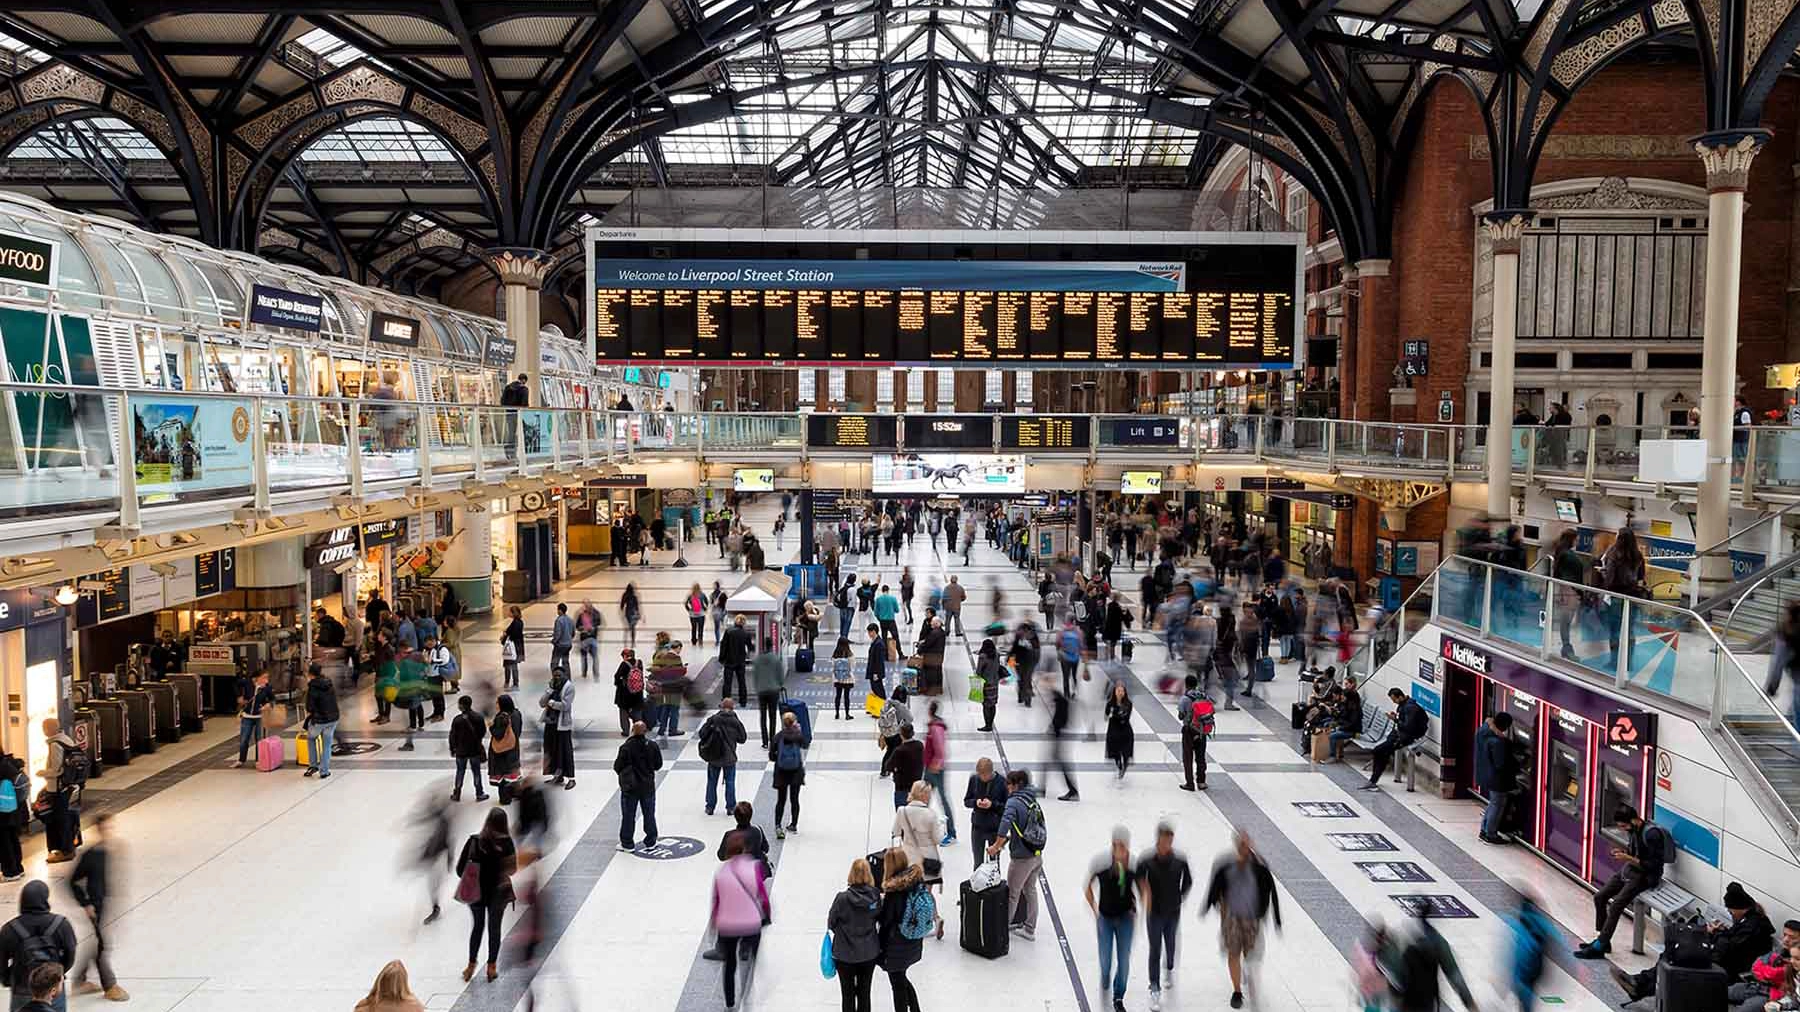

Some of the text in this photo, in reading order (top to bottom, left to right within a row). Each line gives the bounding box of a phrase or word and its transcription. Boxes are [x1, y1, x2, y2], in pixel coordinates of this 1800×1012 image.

[599, 230, 637, 239] Departures
[618, 269, 834, 284] Welcome to Liverpool Street Station
[8, 362, 66, 399] M&S
[1130, 427, 1145, 436] Lift
[328, 527, 353, 544] AMT
[224, 549, 232, 570] 5
[319, 542, 355, 565] COFFEE
[1649, 545, 1697, 562] UNDERGRO
[1727, 558, 1752, 573] TION
[1452, 643, 1487, 672] NatWest
[639, 845, 673, 858] Lift
